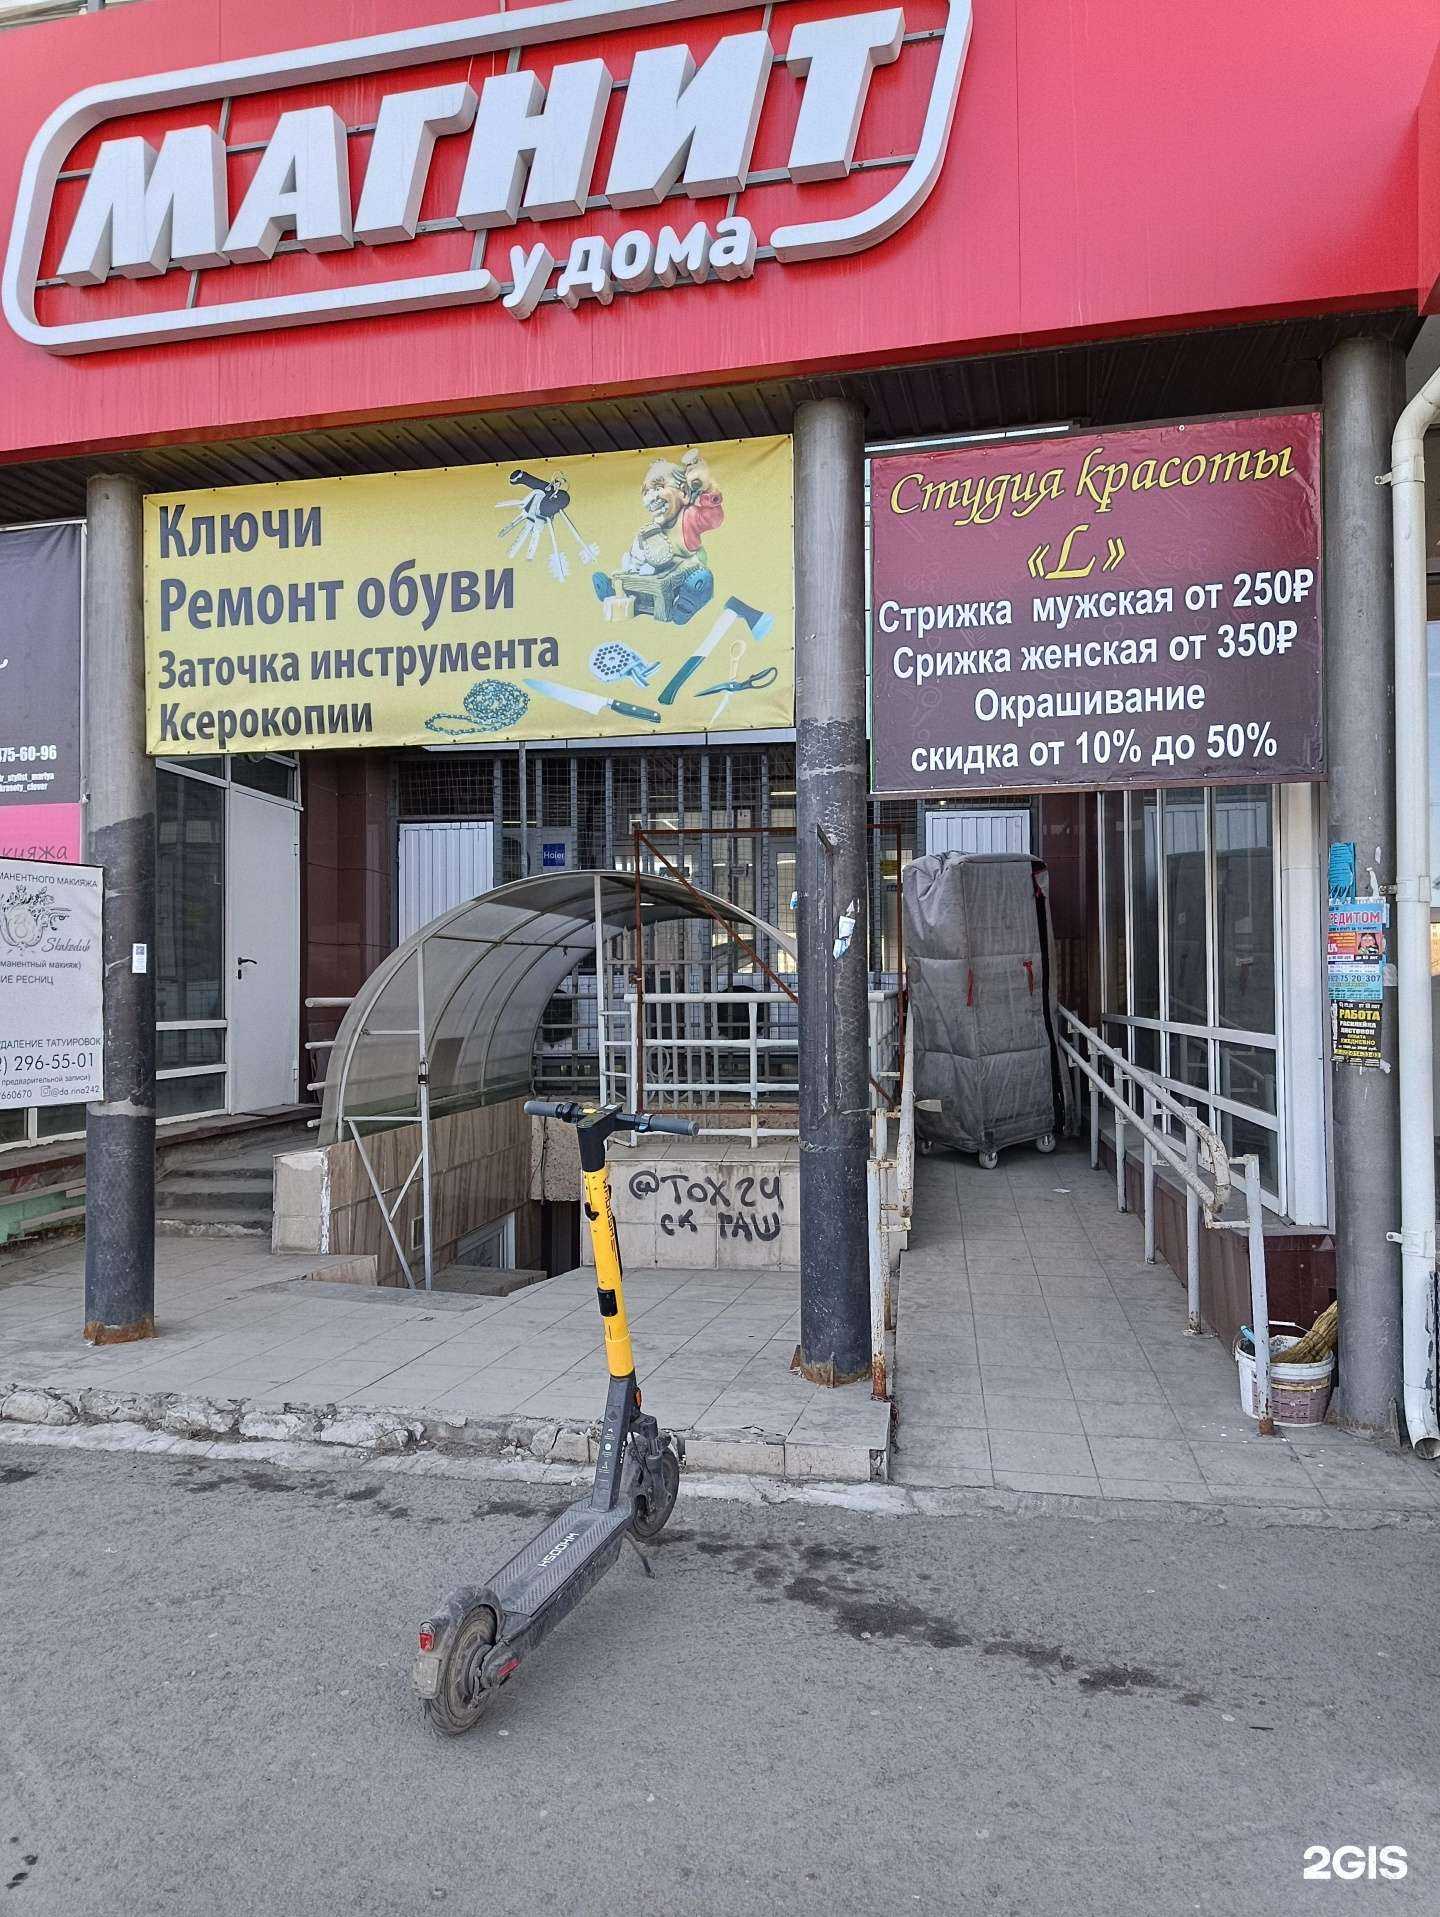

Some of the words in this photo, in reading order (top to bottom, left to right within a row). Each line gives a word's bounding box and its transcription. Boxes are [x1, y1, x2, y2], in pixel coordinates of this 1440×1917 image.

[58, 6, 907, 286] МАГНИТ
[502, 242, 553, 319] у
[558, 216, 757, 310] дома
[890, 468, 1065, 526] Студия
[1076, 446, 1295, 513] красоты
[160, 505, 322, 558] Ключи
[160, 578, 344, 632] Ремонт
[358, 559, 515, 632] обуви
[878, 600, 1012, 638] Стрижка
[1033, 589, 1173, 629] мужская
[1185, 583, 1222, 610] от
[158, 649, 300, 690] Заточка
[311, 636, 560, 687] инструмента
[893, 647, 1011, 685] Срижка
[1021, 638, 1157, 671] женская
[1169, 633, 1207, 662] от
[160, 702, 373, 748] Ксерокопии
[974, 684, 1206, 727] Окрашивание
[0, 745, 57, 762] 75-60-96
[911, 741, 1018, 774] скидка
[1029, 738, 1064, 768] от
[1075, 729, 1142, 764] 10%
[1151, 734, 1195, 766] до
[1207, 721, 1277, 758] 50%
[543, 851, 565, 860] Haier
[57, 877, 98, 888] МАКИЯЖА
[16, 976, 54, 985] РЕСНИЦ
[1339, 1009, 1380, 1021] РАБОТА
[14, 1052, 95, 1072] 296-55-01
[46, 1037, 101, 1047] ТАТУИРОВОК
[0, 1090, 32, 1100] 660670
